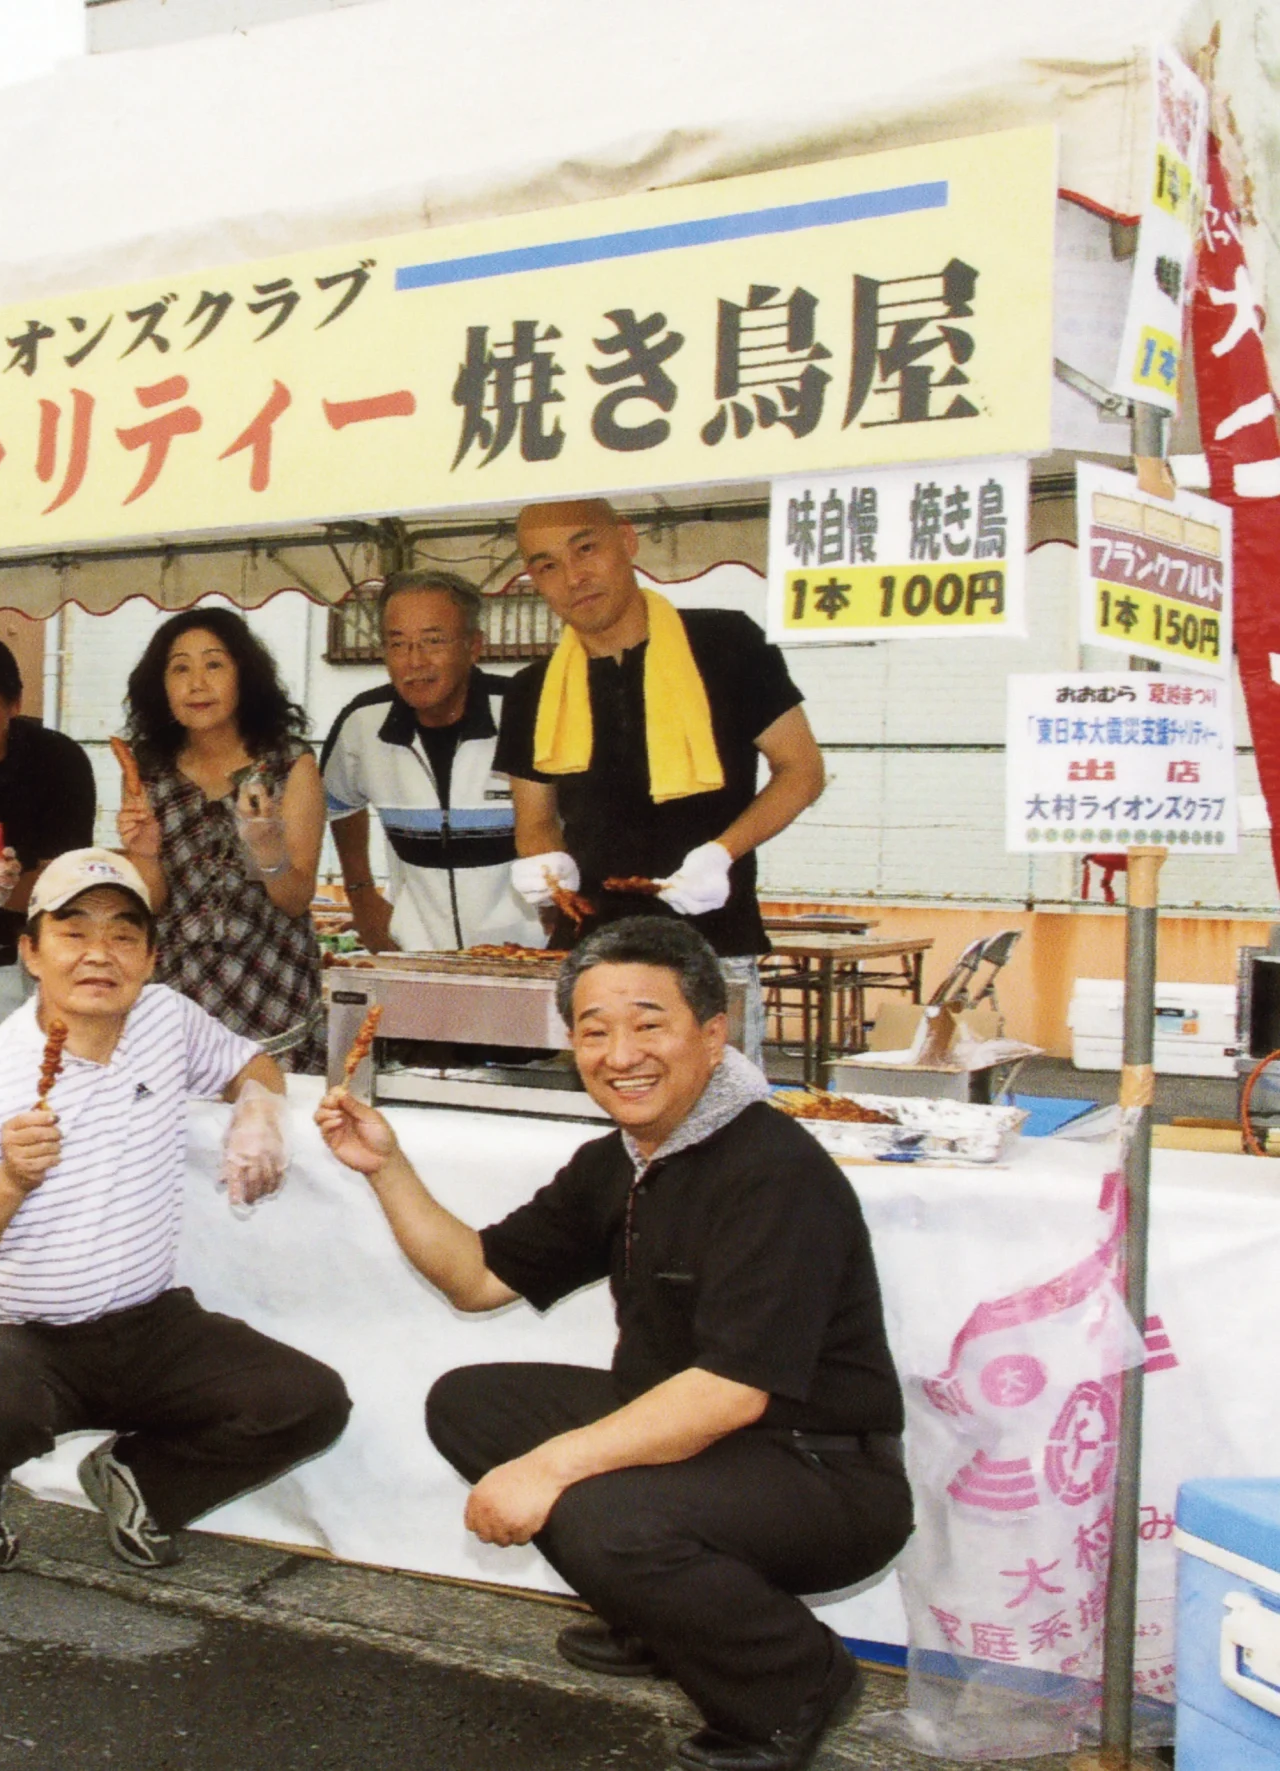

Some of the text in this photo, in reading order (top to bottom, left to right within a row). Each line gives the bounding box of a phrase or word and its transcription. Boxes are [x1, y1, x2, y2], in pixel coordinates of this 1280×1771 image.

[450, 258, 980, 474] 焼き鳥屋
[786, 478, 1008, 566] 味自慢 焼き鳥
[792, 570, 1005, 620] 1本 100円
[1090, 537, 1224, 602] フランクフルト
[1100, 590, 1220, 657] 1本 150円
[1055, 682, 1217, 708] おおむら 夏越まつり
[1025, 793, 1226, 822] 大村ライオンズクラブ
